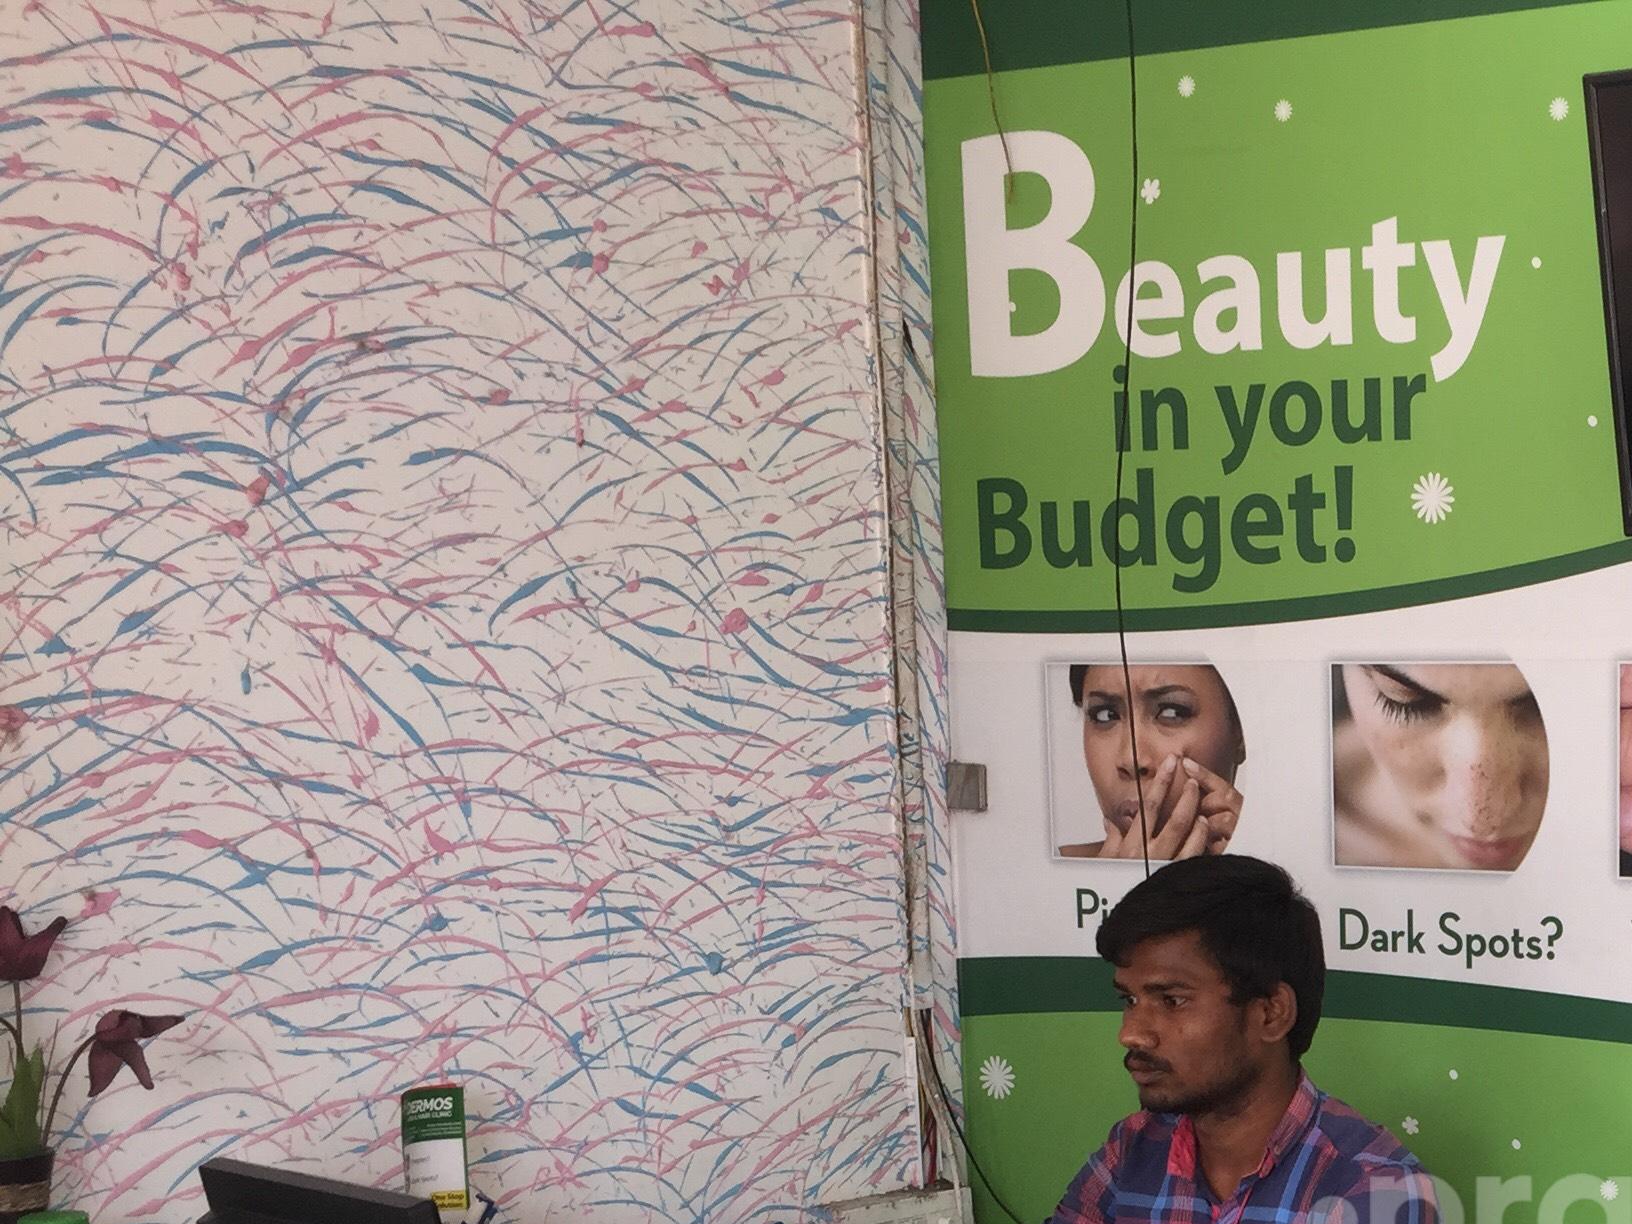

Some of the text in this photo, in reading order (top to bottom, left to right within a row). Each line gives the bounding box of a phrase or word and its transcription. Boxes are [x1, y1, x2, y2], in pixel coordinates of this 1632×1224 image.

[962, 131, 1506, 383] Beauty
[1112, 365, 1427, 476] in your
[976, 465, 1356, 594] Budget!
[1339, 907, 1564, 970] Dark Spots?
